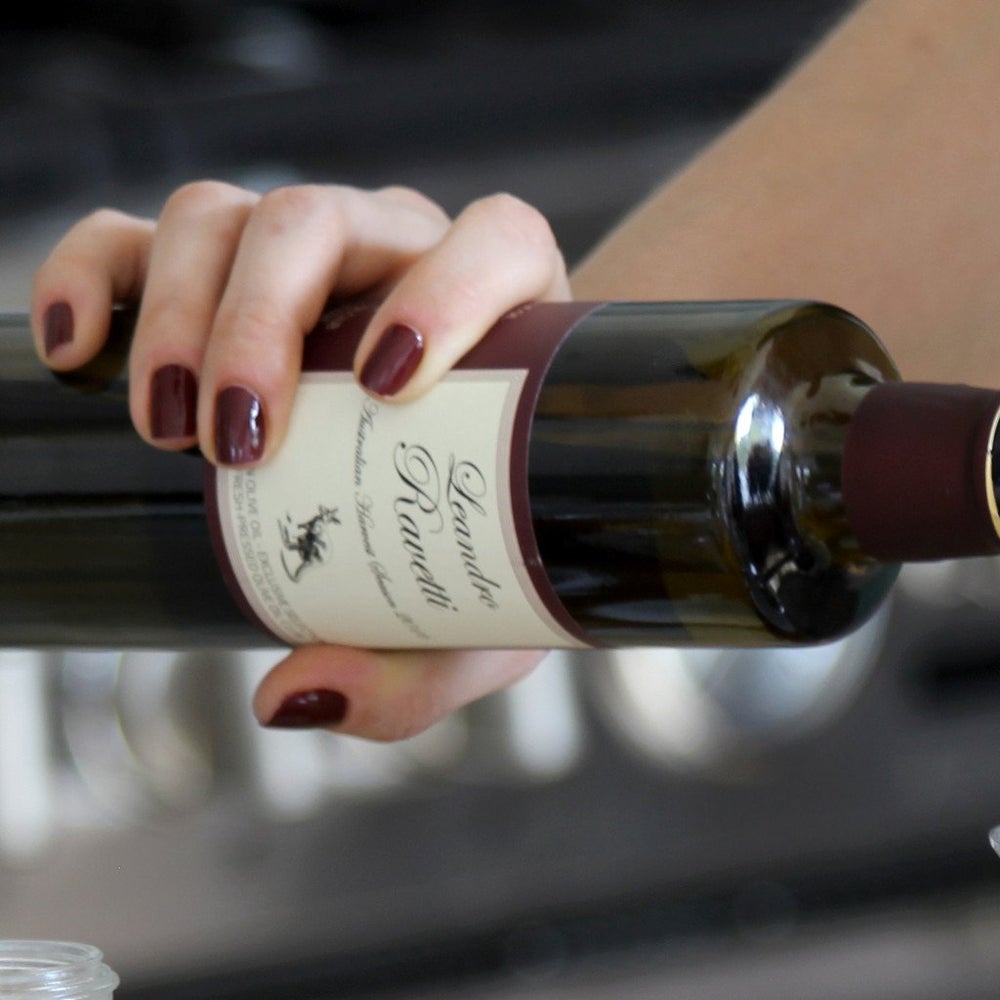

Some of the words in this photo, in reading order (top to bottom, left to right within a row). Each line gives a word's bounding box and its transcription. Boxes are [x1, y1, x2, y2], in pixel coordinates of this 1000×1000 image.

[354, 397, 379, 487] Australian
[245, 479, 259, 515] OLIVE
[250, 519, 263, 540] OIL
[355, 492, 375, 558] Harvest
[393, 441, 458, 612] Ravetti
[447, 453, 501, 610] Leandro
